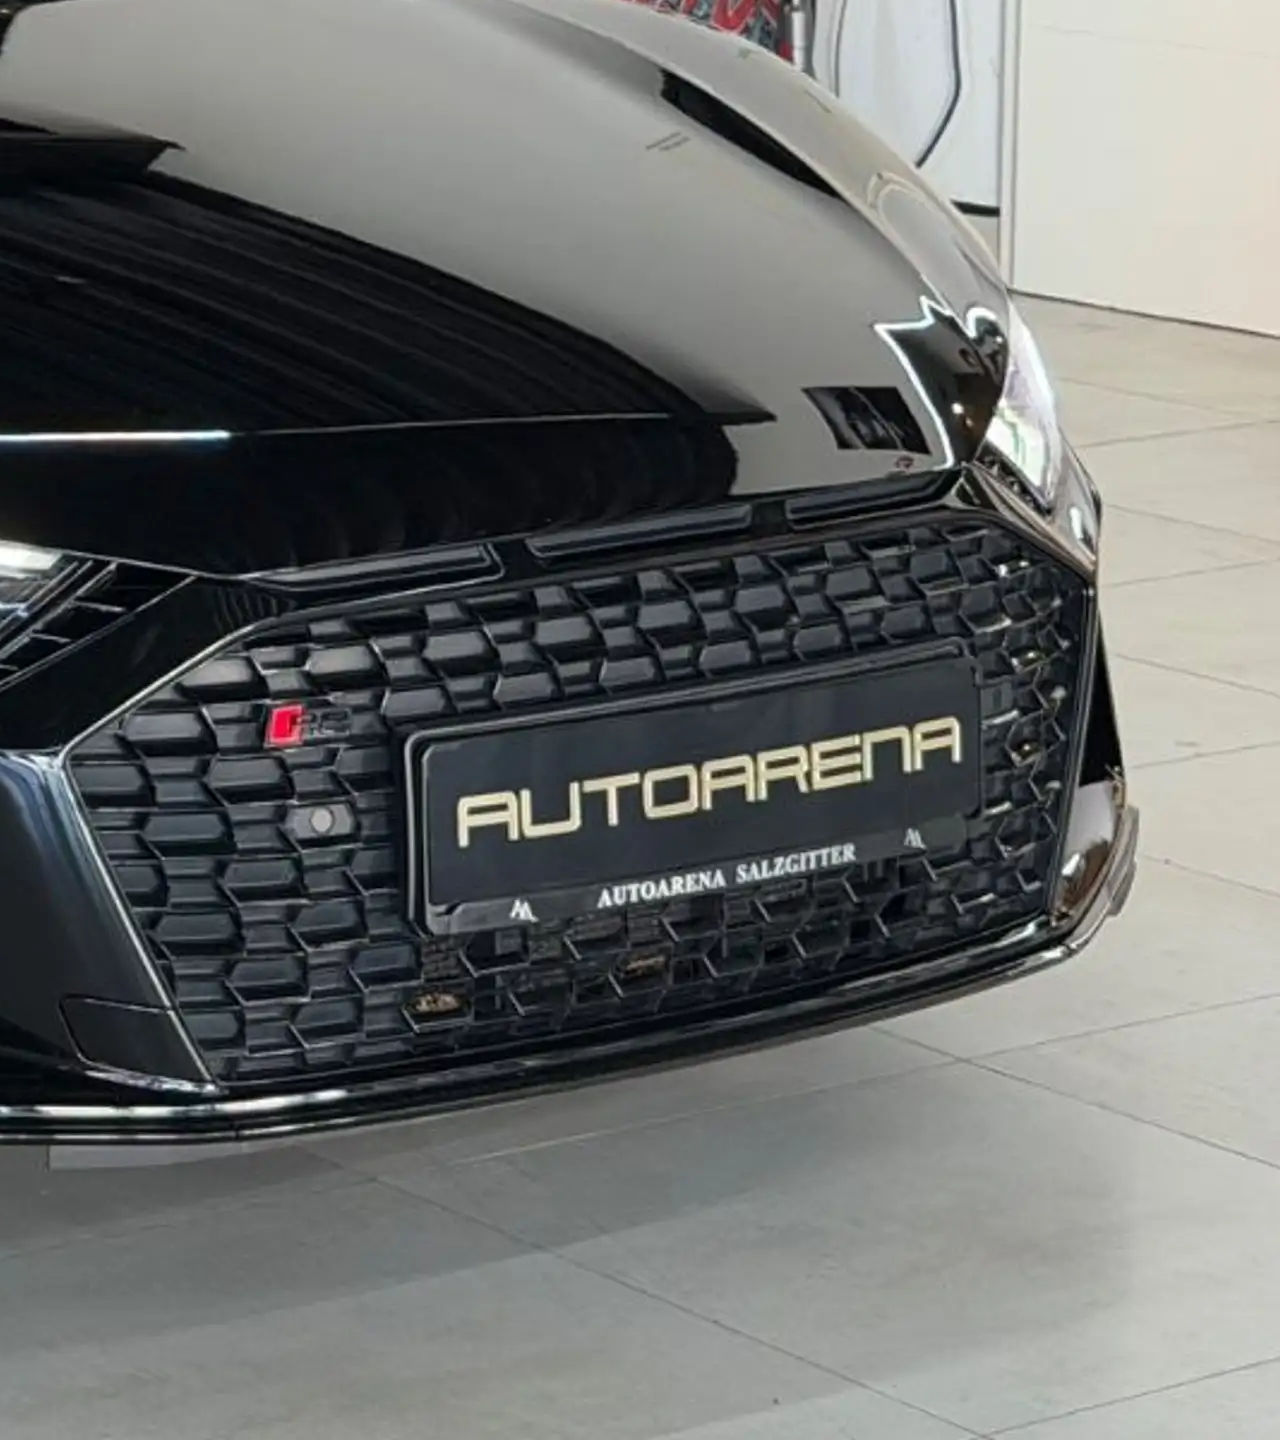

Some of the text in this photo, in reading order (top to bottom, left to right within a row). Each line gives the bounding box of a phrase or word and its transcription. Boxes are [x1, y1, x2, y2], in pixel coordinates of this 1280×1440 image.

[456, 715, 963, 849] AUTOARENA
[597, 842, 857, 910] AUTOARENA SALZGITTER
